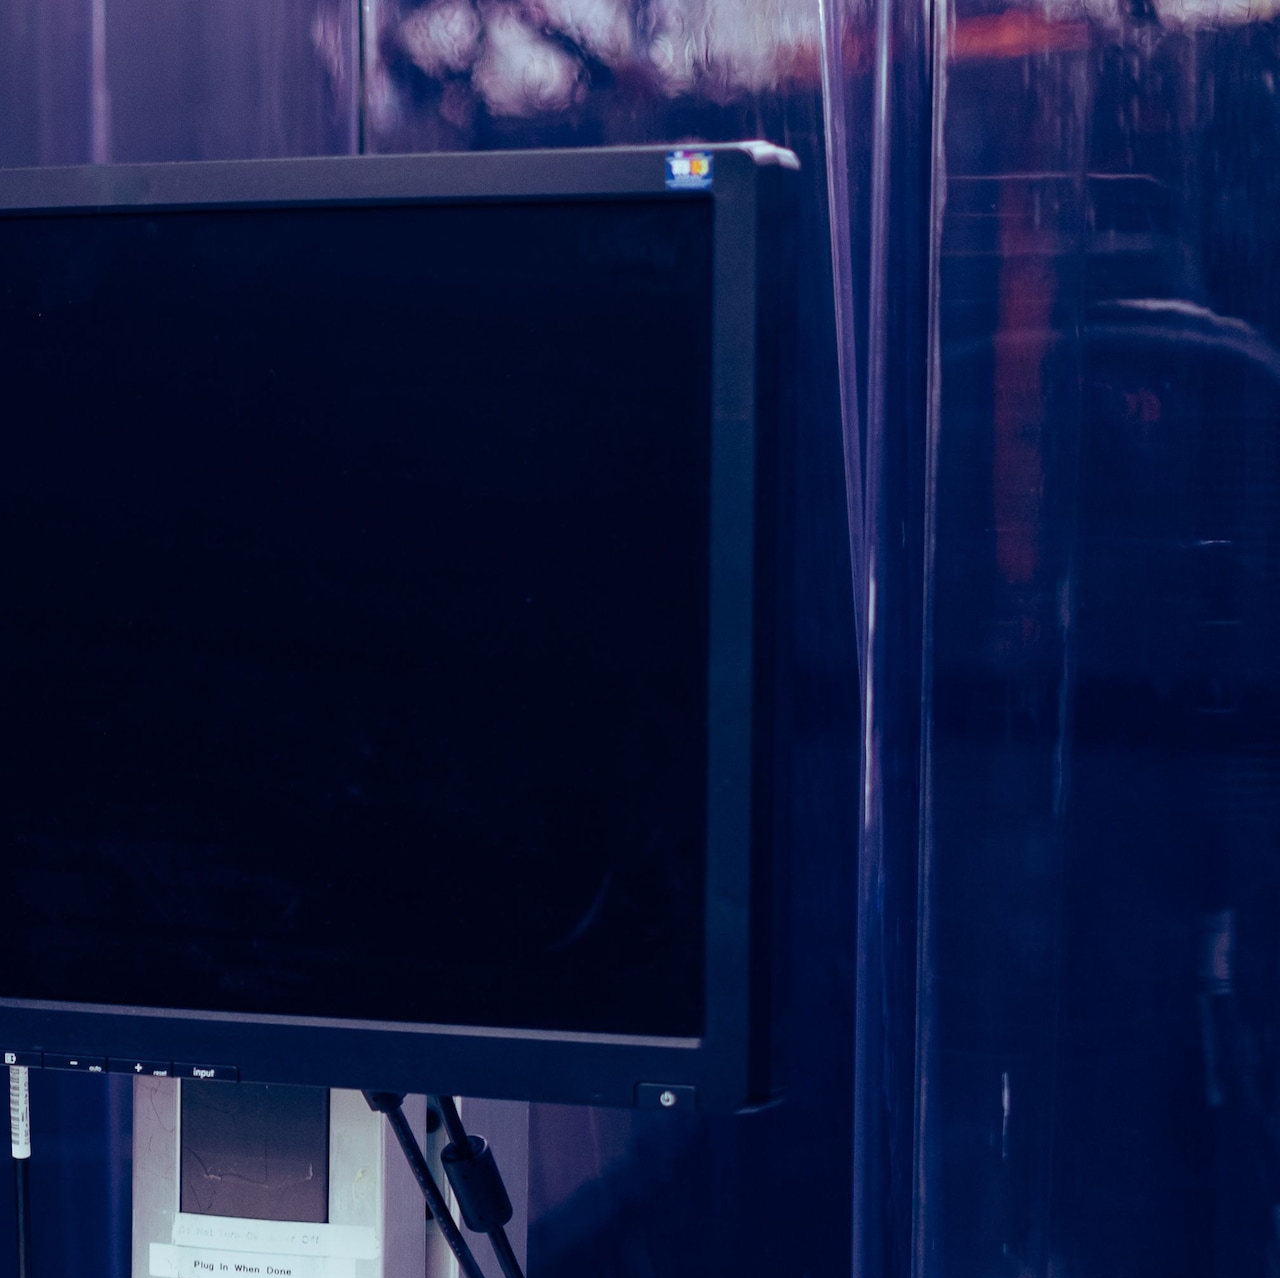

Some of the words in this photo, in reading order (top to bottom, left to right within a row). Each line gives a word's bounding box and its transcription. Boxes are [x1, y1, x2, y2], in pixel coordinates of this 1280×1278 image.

[193, 1067, 215, 1079] input
[196, 1227, 214, 1238] Not
[301, 1234, 320, 1245] Off
[193, 1260, 214, 1271] Plug
[220, 1263, 229, 1271] In
[234, 1263, 260, 1274] When
[266, 1266, 292, 1276] Done
